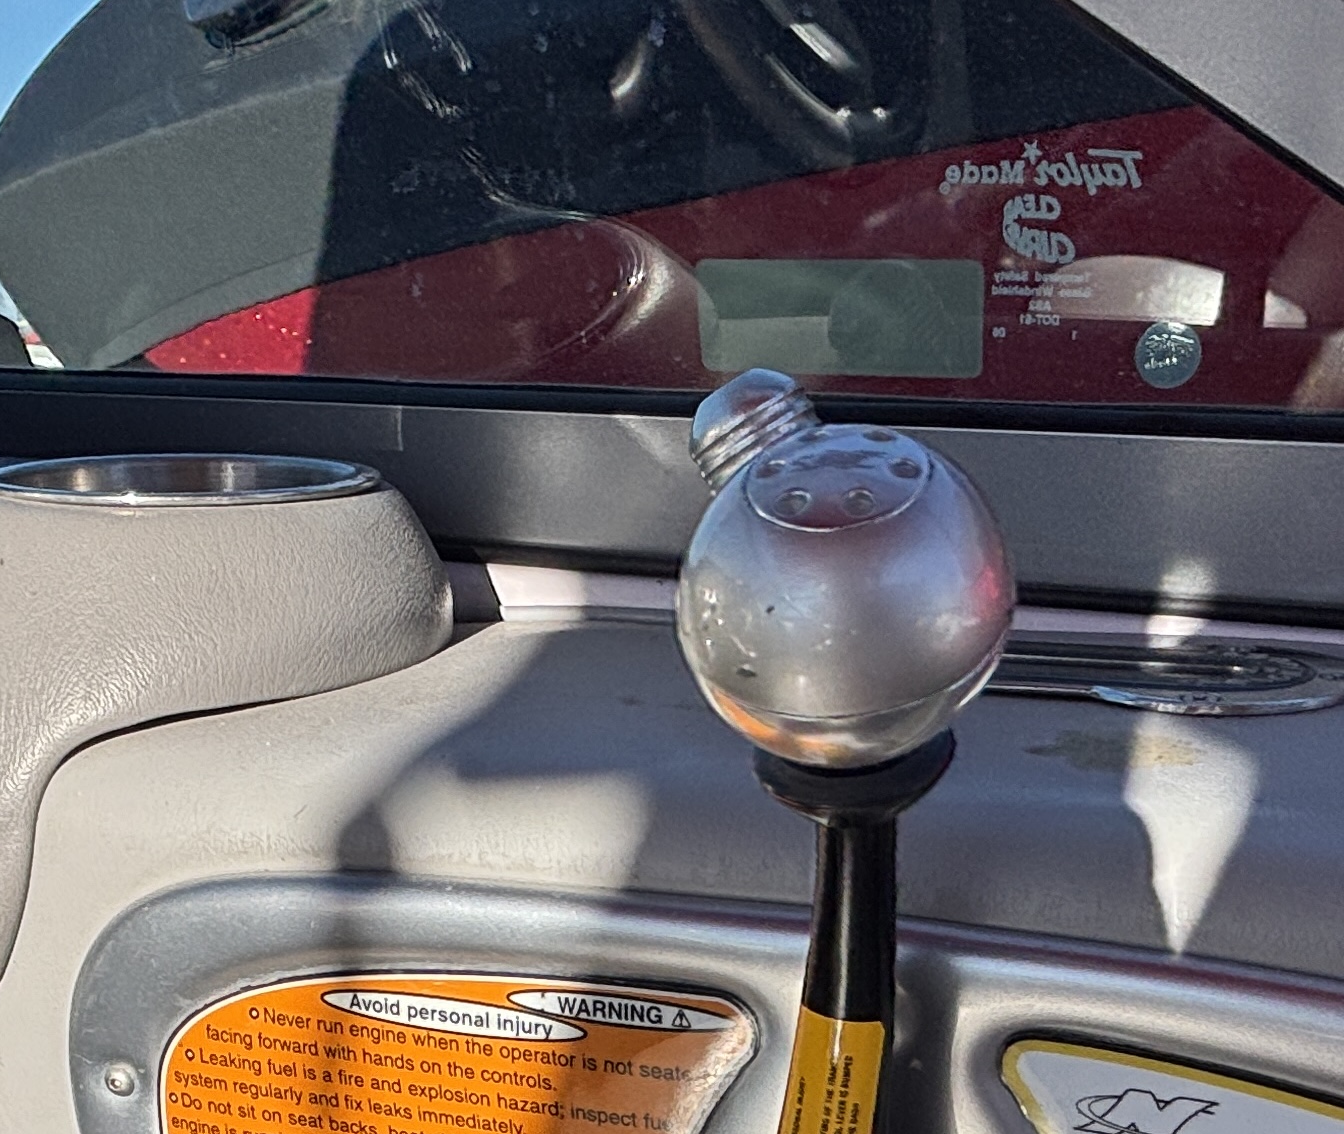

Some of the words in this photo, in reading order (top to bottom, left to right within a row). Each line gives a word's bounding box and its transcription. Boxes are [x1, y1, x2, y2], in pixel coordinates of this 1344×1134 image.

[349, 991, 400, 1015] Avoid
[407, 1005, 489, 1028] personal
[497, 1013, 552, 1043] injury
[557, 996, 664, 1025] WARNING
[263, 1006, 311, 1029] Never
[316, 1018, 343, 1035] run
[348, 1024, 406, 1045] engine
[412, 1033, 460, 1053] when
[466, 1038, 495, 1056] the
[499, 1045, 576, 1069] operator
[581, 1052, 597, 1071] is
[603, 1057, 633, 1076] not
[638, 1064, 693, 1082] seate
